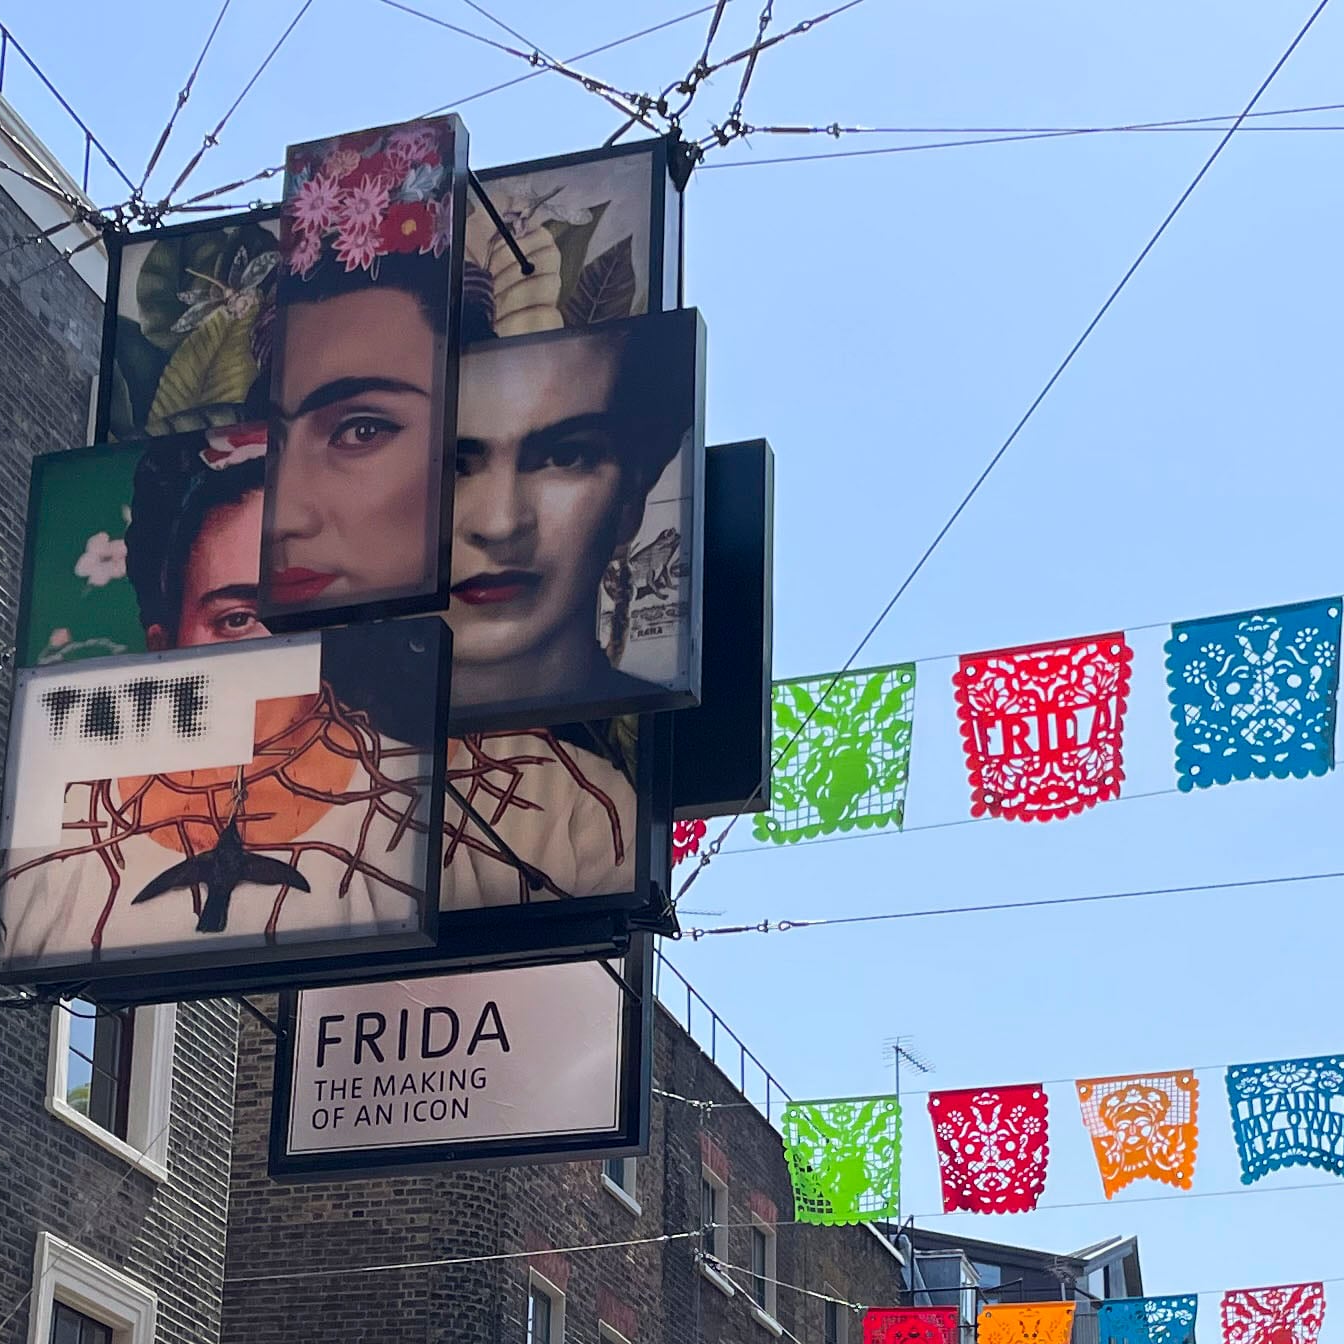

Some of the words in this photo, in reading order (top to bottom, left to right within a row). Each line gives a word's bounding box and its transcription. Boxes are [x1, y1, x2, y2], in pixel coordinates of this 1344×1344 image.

[42, 674, 210, 738] TATE
[317, 1001, 511, 1067] FRIDA
[314, 1077, 363, 1101] THE
[373, 1067, 487, 1099] MAKING
[312, 1107, 345, 1129] OF
[354, 1103, 393, 1127] AN
[404, 1097, 469, 1123] ICON
[1260, 1091, 1333, 1114] PAINT
[1241, 1112, 1276, 1140] MY
[1287, 1111, 1343, 1136] OWN
